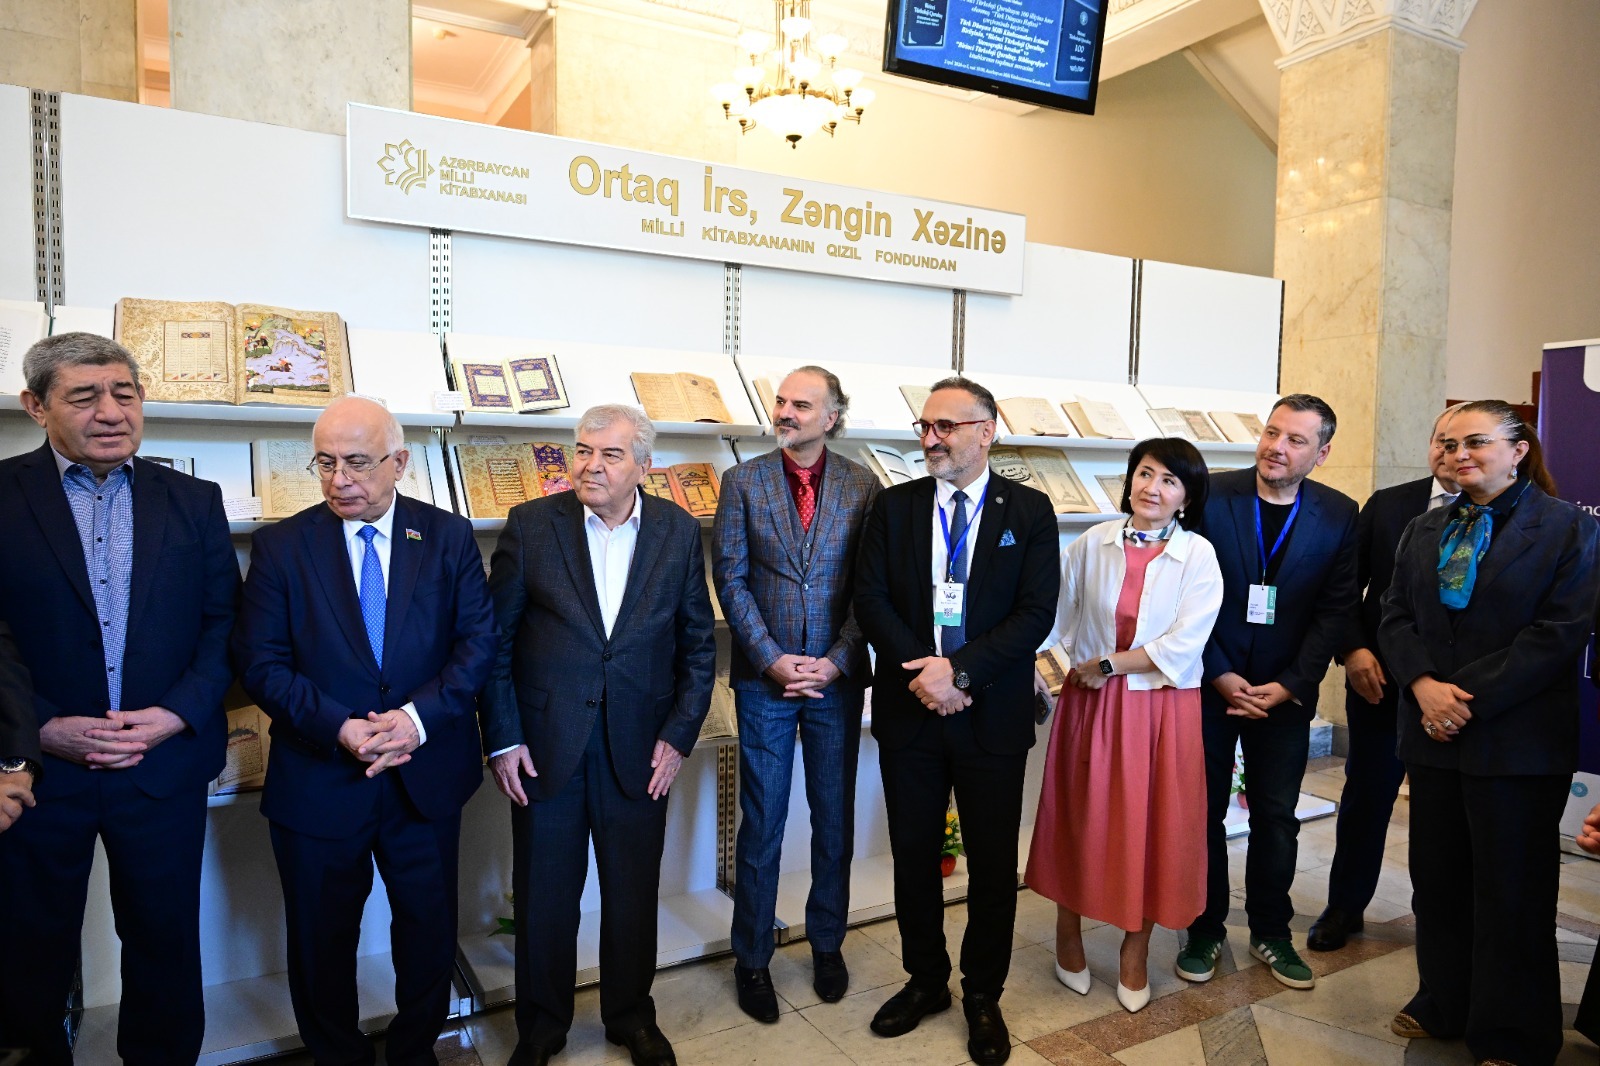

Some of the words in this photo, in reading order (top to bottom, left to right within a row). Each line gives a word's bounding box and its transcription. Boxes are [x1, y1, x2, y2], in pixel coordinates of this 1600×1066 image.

[439, 155, 530, 179] AZƏRBAYCAN
[439, 168, 475, 185] MİLLİ
[439, 183, 528, 206] KİTABXANASI
[568, 155, 680, 217] Ortaq
[703, 165, 758, 226] İrs,
[780, 187, 892, 242] Zəngin
[911, 208, 1007, 254] Xəzinə
[641, 217, 685, 238] MİLLİ
[701, 225, 815, 254] KİTABXANANIN
[826, 243, 862, 261] QIZIL
[875, 249, 957, 272] FONDUNDAN
